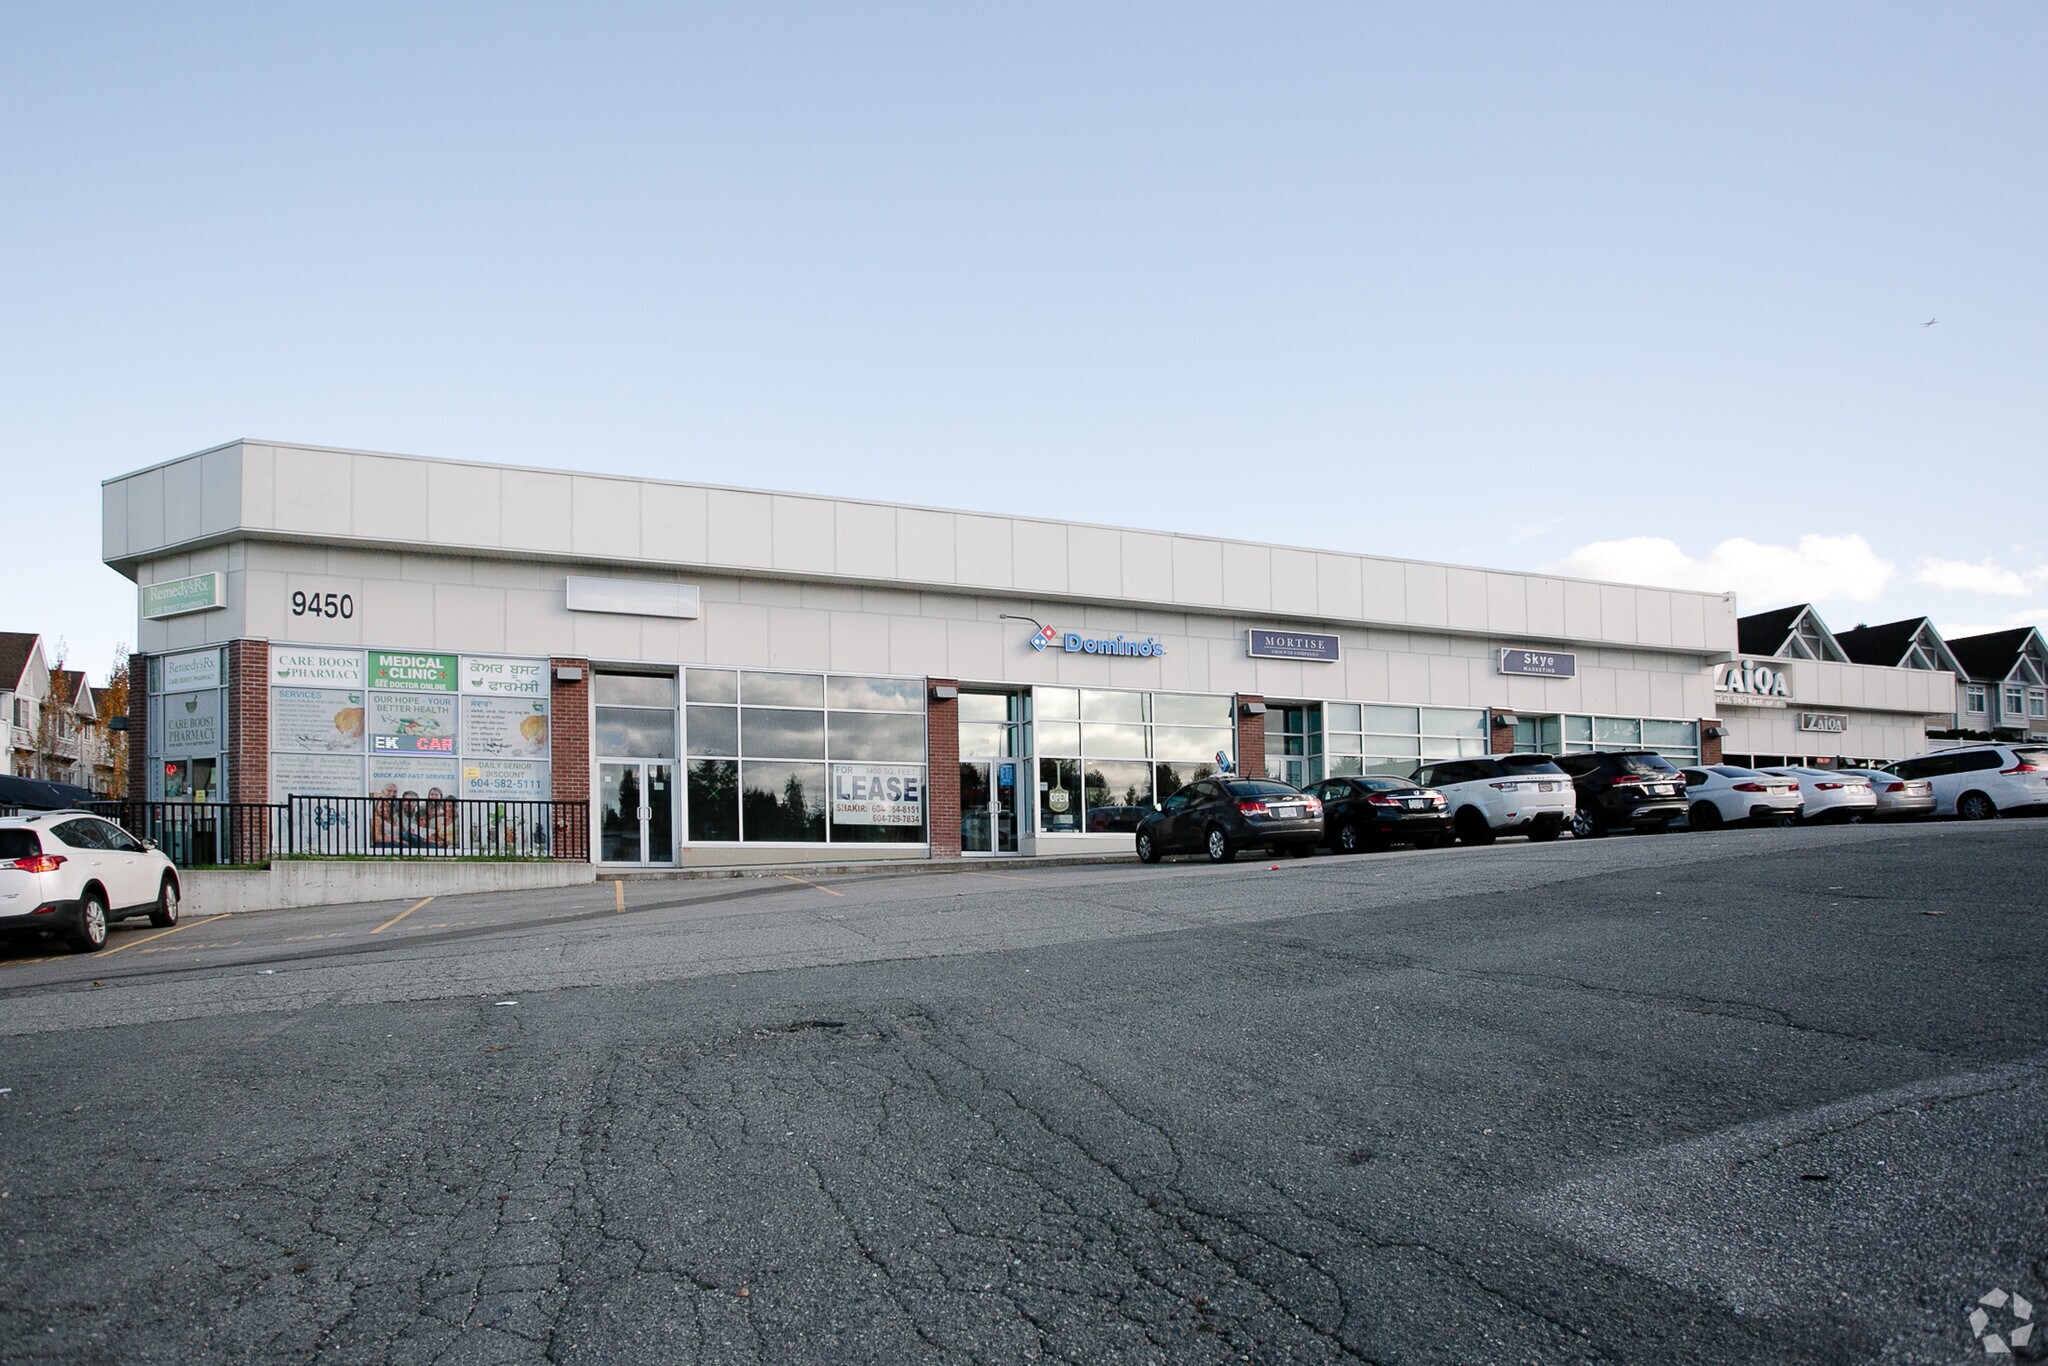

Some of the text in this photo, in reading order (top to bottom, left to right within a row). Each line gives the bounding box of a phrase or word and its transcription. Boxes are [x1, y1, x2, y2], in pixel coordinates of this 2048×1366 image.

[292, 590, 354, 619] 9450
[1063, 632, 1164, 657] Domino's
[1265, 636, 1326, 650] MORTISE
[279, 655, 361, 668] CARE BOOST
[379, 655, 445, 669] MEDICAL
[1523, 652, 1555, 667] Skye
[291, 669, 360, 680] PHARMACY
[389, 667, 437, 680] CLINIC
[1523, 666, 1556, 674] MARKETING
[374, 679, 447, 691] SEE DOCTOR ONLINE
[279, 690, 322, 699] SERVICES
[374, 695, 393, 703] OUR
[395, 697, 419, 705] HOPE
[427, 698, 451, 706] YOUR
[377, 704, 449, 714] BETTER HEALTH
[168, 716, 215, 730] CARE BOOST
[169, 727, 217, 742] PHARMACY
[503, 762, 532, 770] SENIOR
[836, 766, 853, 774] FOR
[866, 767, 882, 775] 1400
[897, 768, 916, 776] FEET
[373, 771, 392, 779] QUICK
[485, 770, 526, 779] DISCOUNT
[470, 778, 541, 789] 604-582-5111
[836, 775, 919, 802] LEASE
[1050, 792, 1069, 803] OPEN
[836, 803, 868, 813] SHAKIR:
